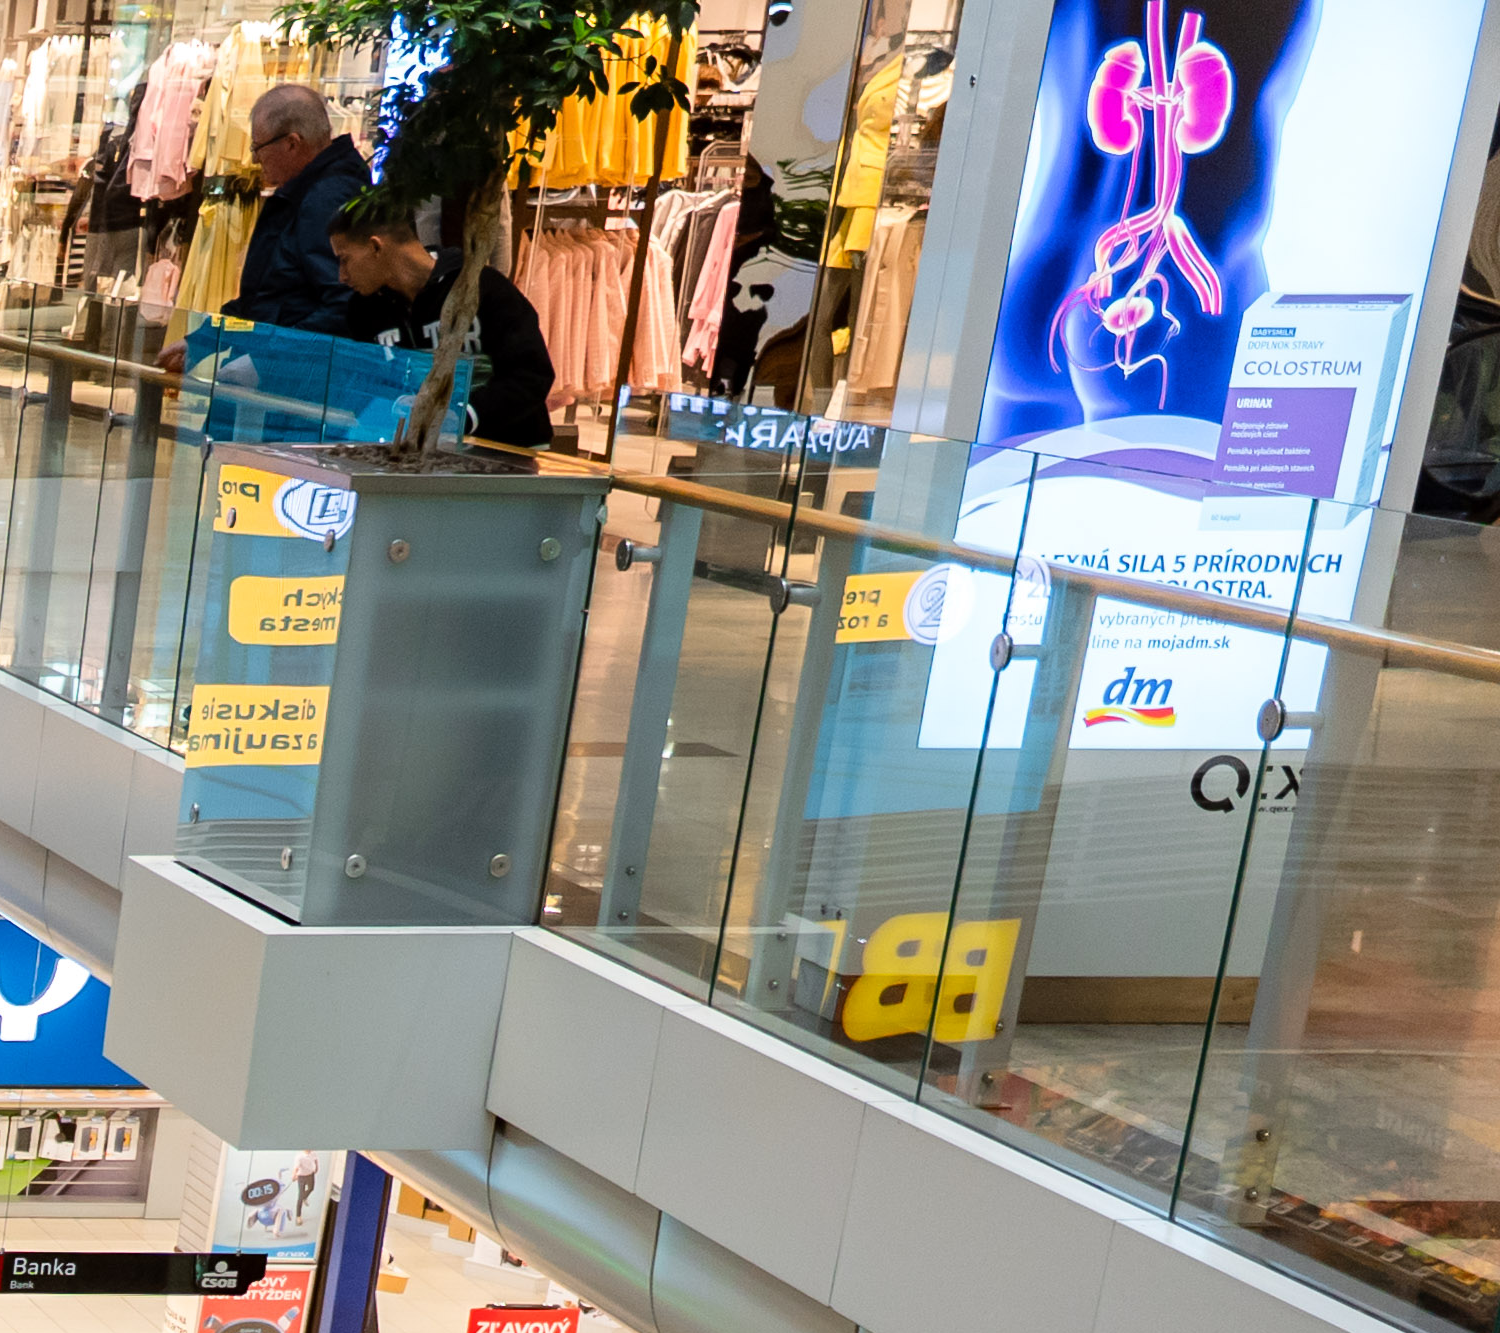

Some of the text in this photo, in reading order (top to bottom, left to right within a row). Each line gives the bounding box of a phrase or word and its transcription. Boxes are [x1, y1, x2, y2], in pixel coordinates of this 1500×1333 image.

[1244, 361, 1361, 375] COLOSTRUM
[1237, 398, 1272, 408] URINAX
[1117, 549, 1342, 573] SILA 5 PRÍRODNCH
[1148, 636, 1230, 651] mojadm.sk
[1103, 667, 1172, 705] dm
[13, 1257, 76, 1276] Banka
[10, 1280, 34, 1290] Bank
[201, 1275, 237, 1289] ČSOB
